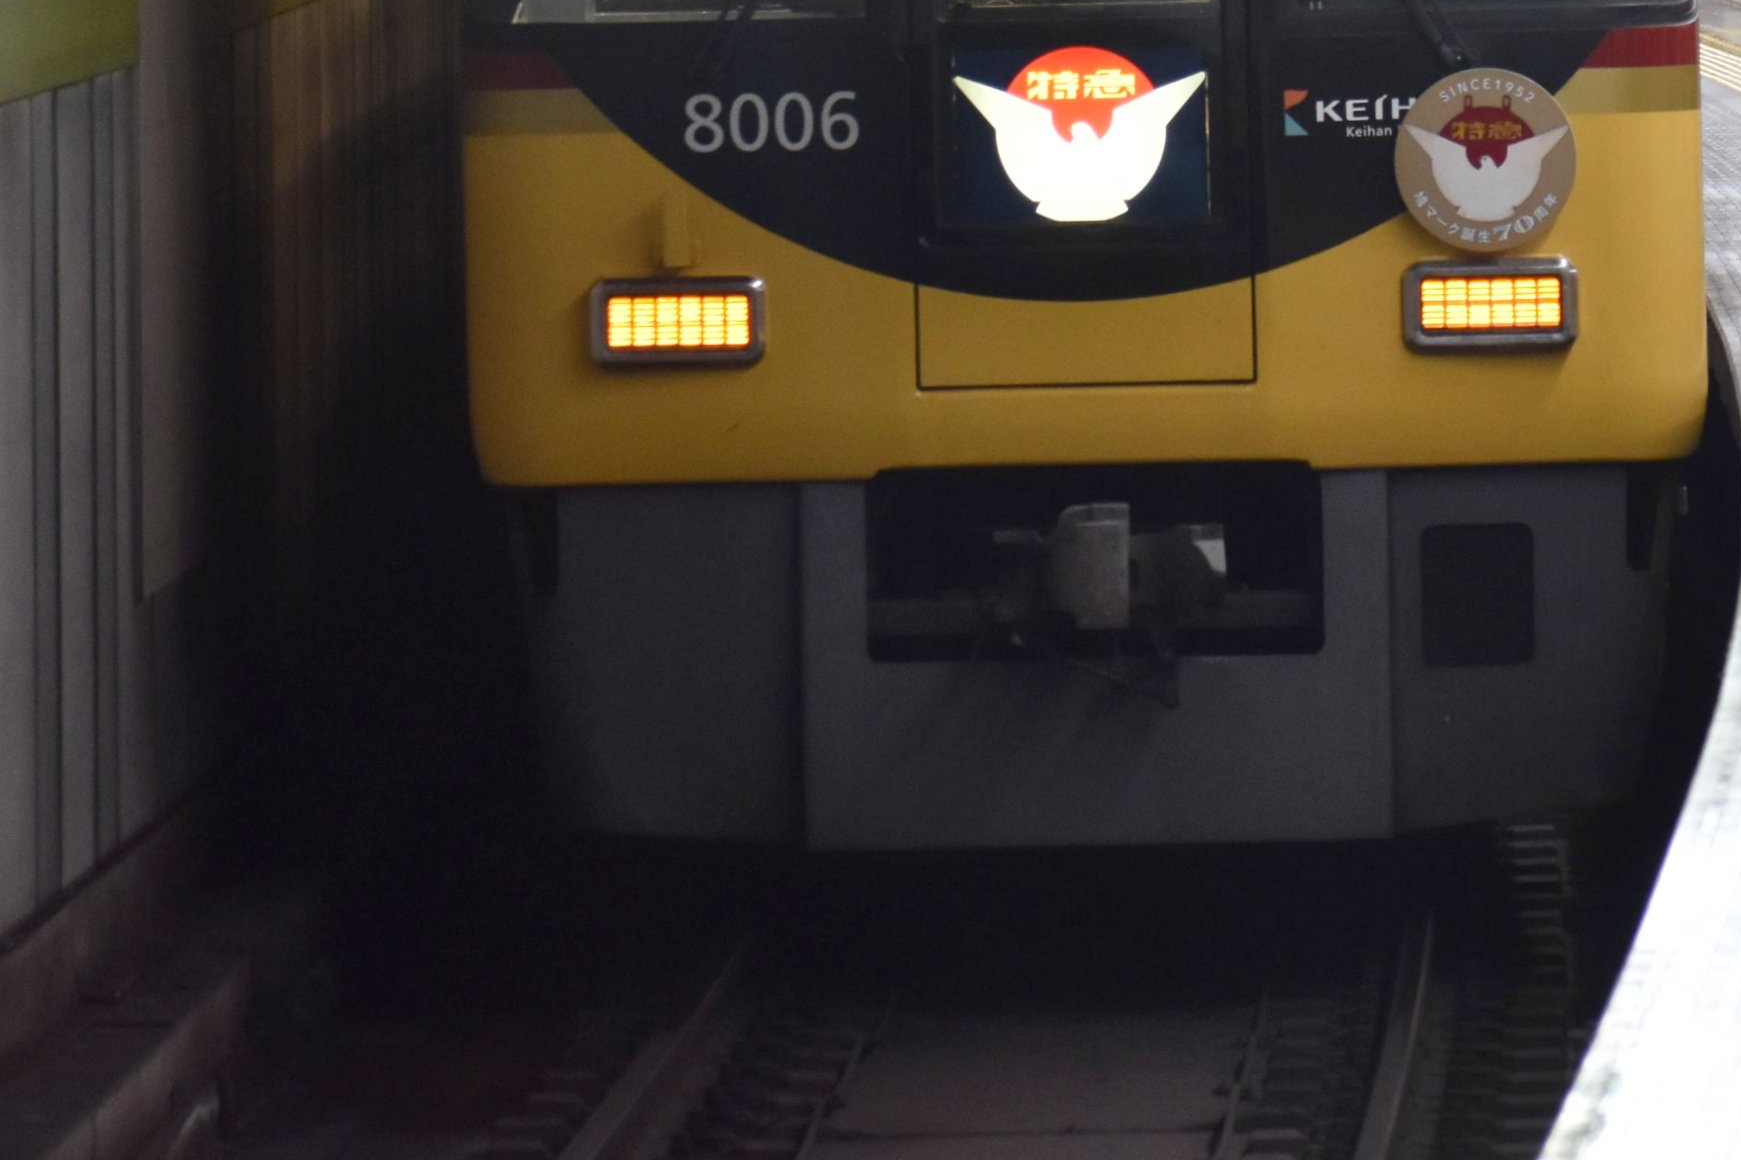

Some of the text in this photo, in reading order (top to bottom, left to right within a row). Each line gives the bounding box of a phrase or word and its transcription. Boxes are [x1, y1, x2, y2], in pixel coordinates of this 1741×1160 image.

[1027, 69, 1136, 101] 特急
[684, 90, 860, 153] 8006
[1346, 125, 1393, 138] Keihan
[1451, 121, 1523, 140] 特急
